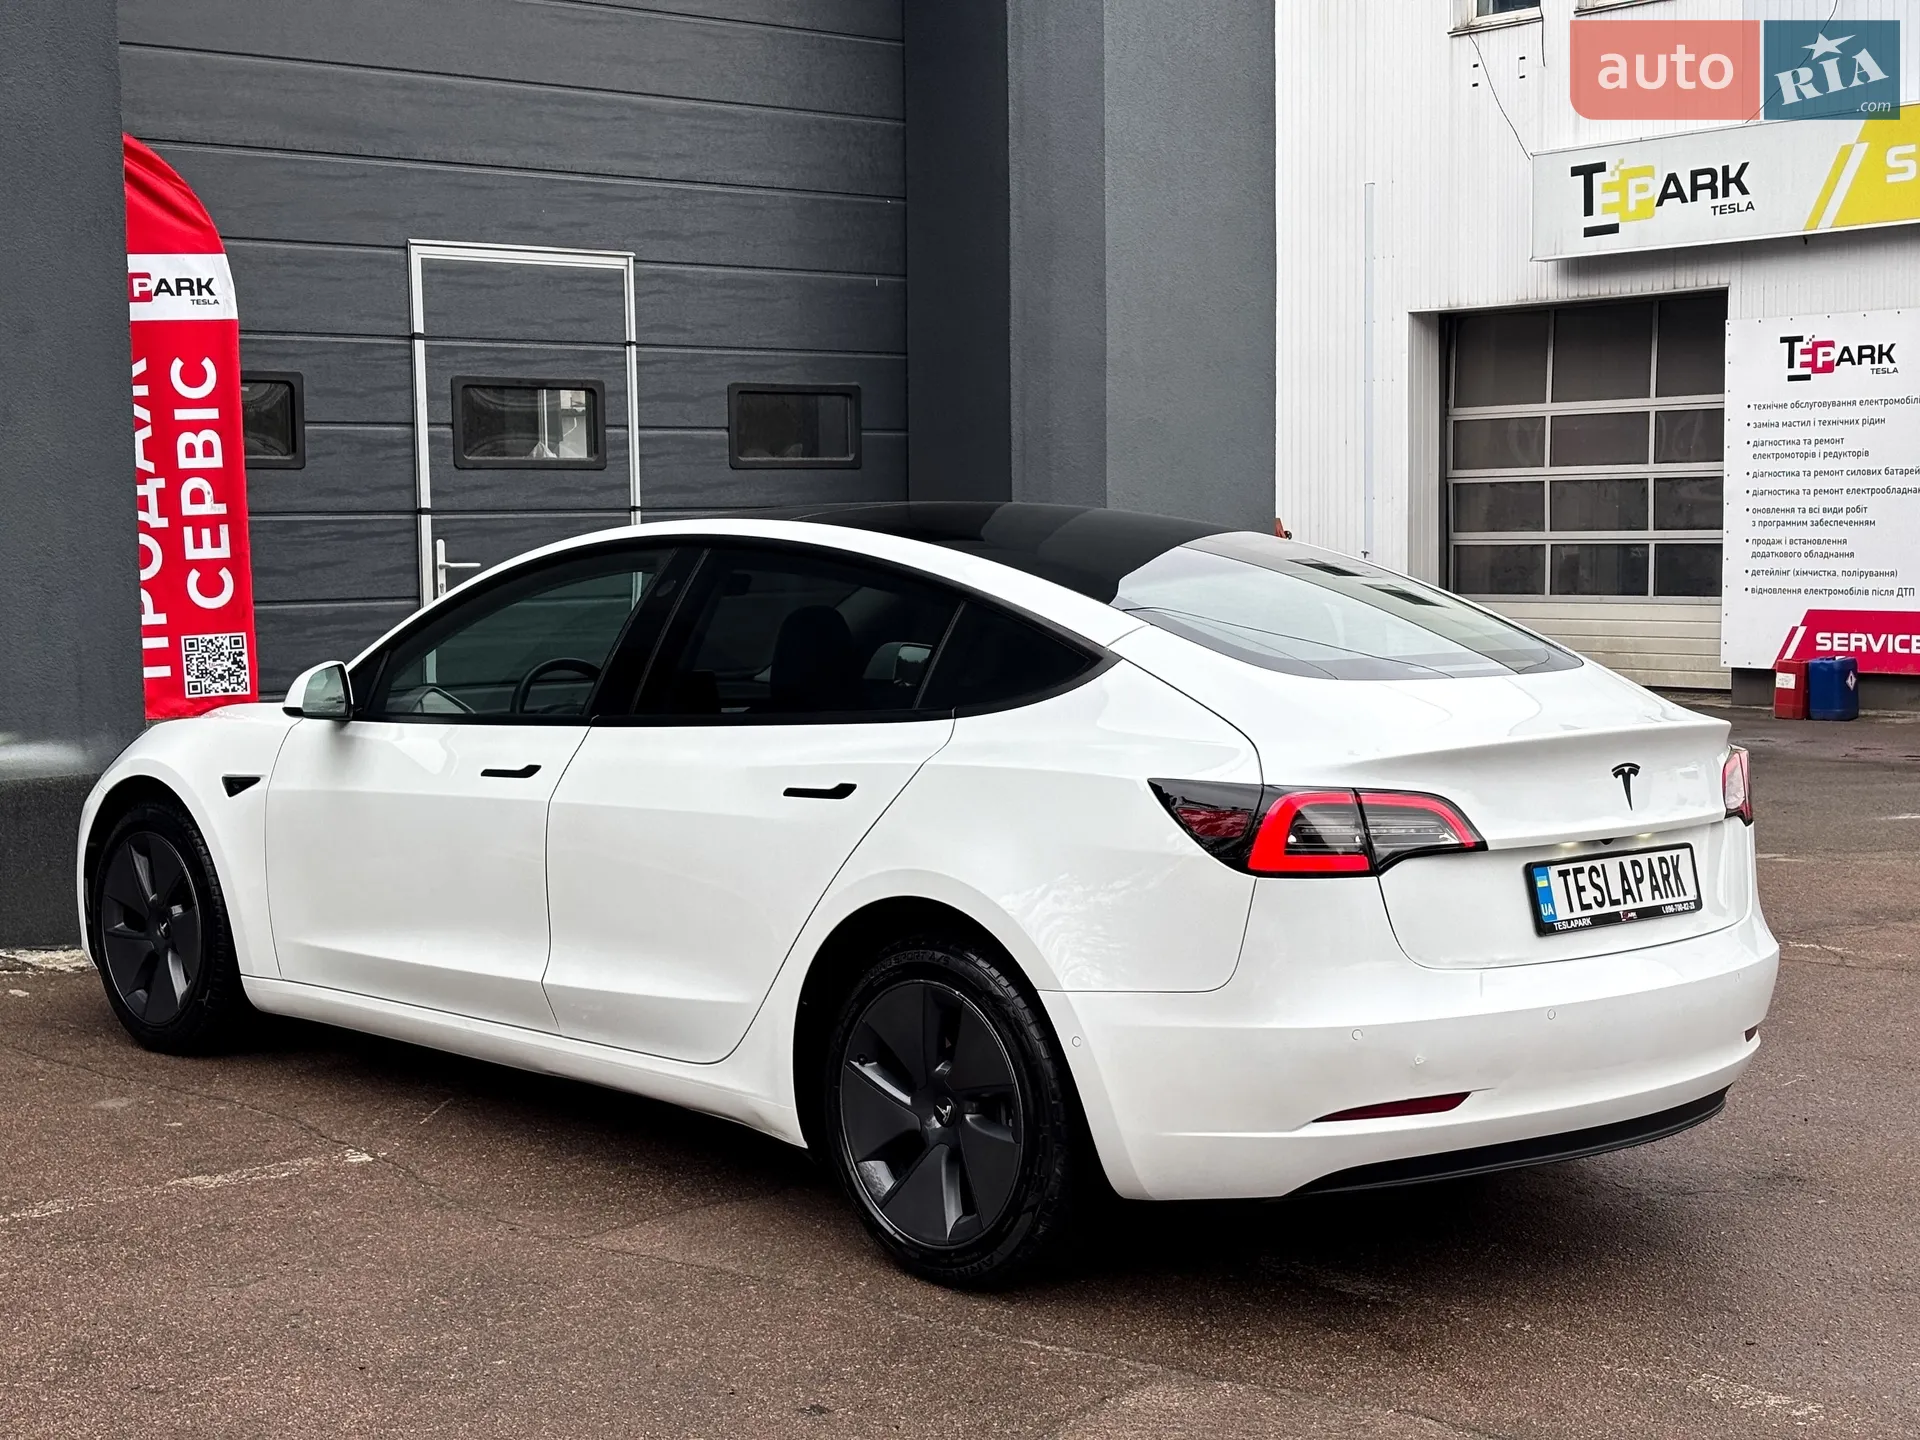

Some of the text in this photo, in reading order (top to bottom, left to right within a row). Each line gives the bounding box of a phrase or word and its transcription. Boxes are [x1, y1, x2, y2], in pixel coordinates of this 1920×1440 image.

[1711, 201, 1755, 216] TESLA
[1871, 367, 1899, 375] TESLA
[1753, 401, 1788, 410] технічне
[1790, 400, 1856, 410] обслуговування
[1753, 419, 1779, 428] заміна
[1818, 417, 1859, 426] технічних
[1862, 416, 1885, 427] рідин
[1753, 438, 1800, 447] діагностика
[1814, 438, 1844, 447] ремонт
[1753, 450, 1816, 461] електромоторів
[1823, 448, 1869, 460] редукторів
[1752, 469, 1800, 478] діагностика
[1814, 470, 1844, 478] ремонт
[1885, 466, 1920, 477] батарей
[170, 356, 234, 610] СЕРВІС
[1752, 488, 1800, 497] діагностика
[1814, 488, 1843, 497] ремонт
[1809, 505, 1820, 513] всі
[1846, 505, 1867, 515] робіт
[1758, 520, 1807, 529] програмним
[1810, 518, 1875, 527] забеспеченням
[1804, 550, 1854, 559] обладнання
[1751, 567, 1897, 579] детейлінг (хімчистка, полірування)
[1751, 585, 1914, 598] відновлення електромобілів після ДТП
[1558, 854, 1687, 913] TESLAPARK
[1541, 903, 1554, 916] UA
[1553, 917, 1592, 931] TESLAPARK
